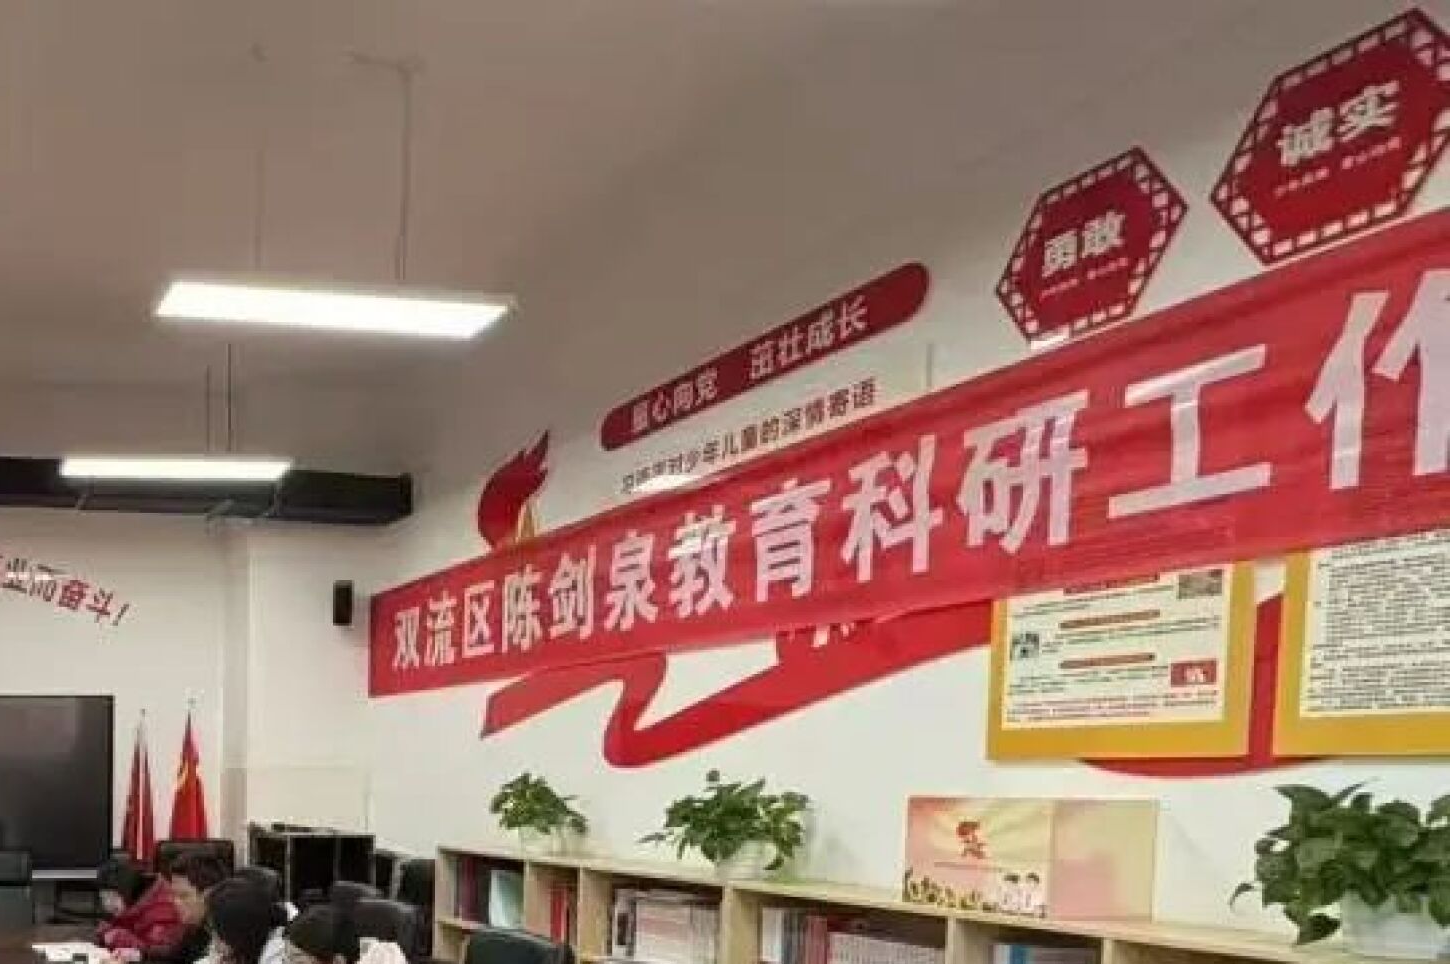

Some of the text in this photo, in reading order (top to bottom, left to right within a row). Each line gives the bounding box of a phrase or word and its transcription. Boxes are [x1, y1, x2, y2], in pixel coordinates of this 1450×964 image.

[1276, 80, 1400, 166] 诚实
[1041, 210, 1127, 278] 勇敢
[750, 294, 869, 381] 茁壮成长
[391, 268, 1450, 672] 双流区陈剑泉教育科研工作
